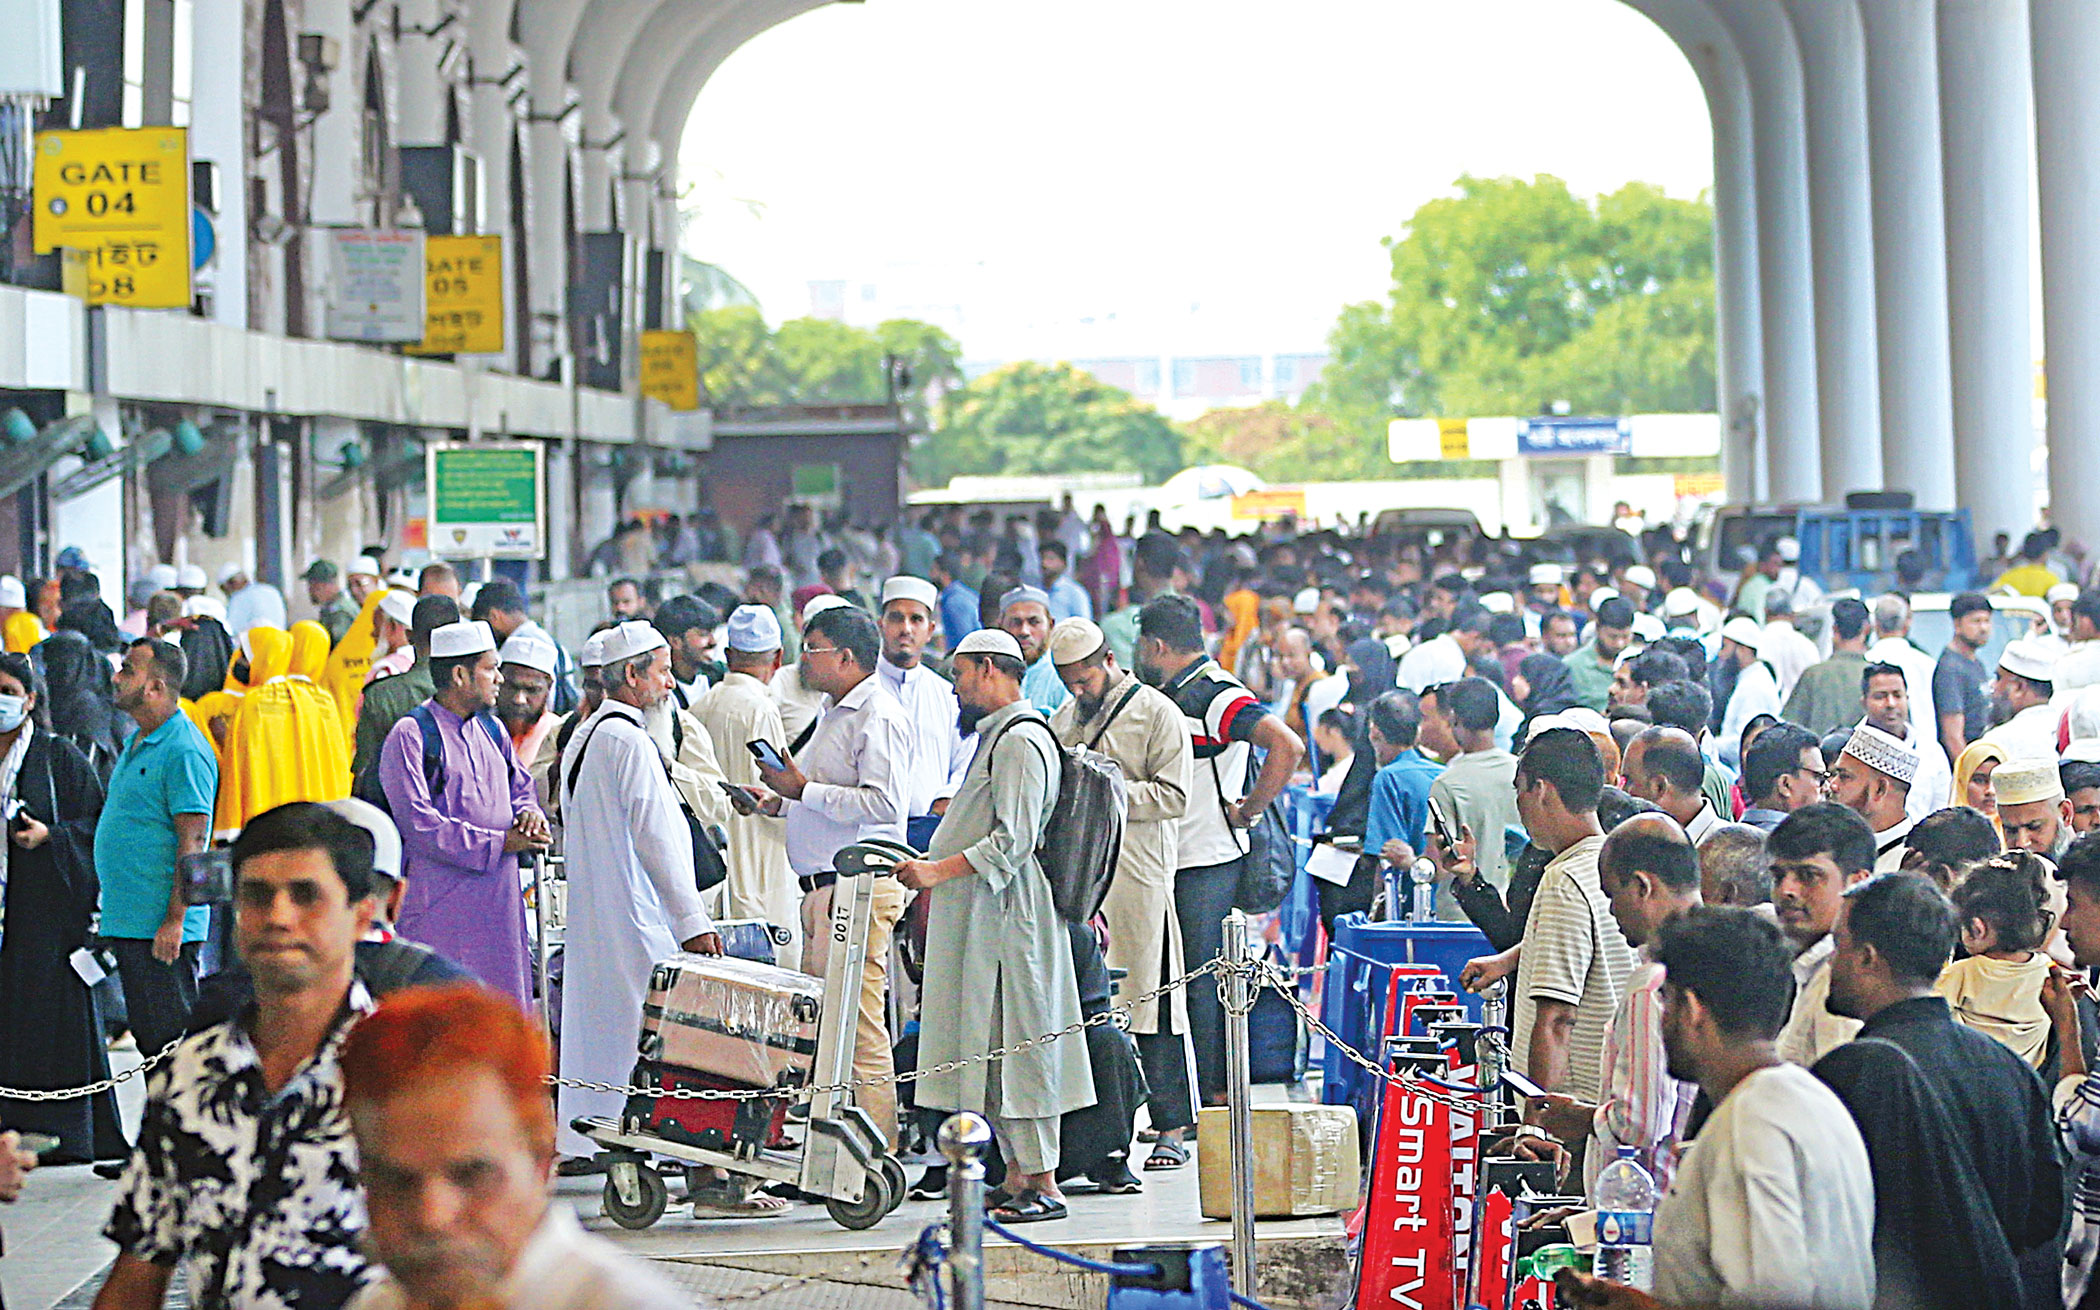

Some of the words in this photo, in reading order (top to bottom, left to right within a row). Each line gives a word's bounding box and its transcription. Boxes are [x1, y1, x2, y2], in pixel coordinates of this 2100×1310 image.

[61, 161, 162, 185] GATE
[86, 191, 136, 217] 04
[1393, 1095, 1434, 1232] Smart
[1389, 1248, 1426, 1310] TV
